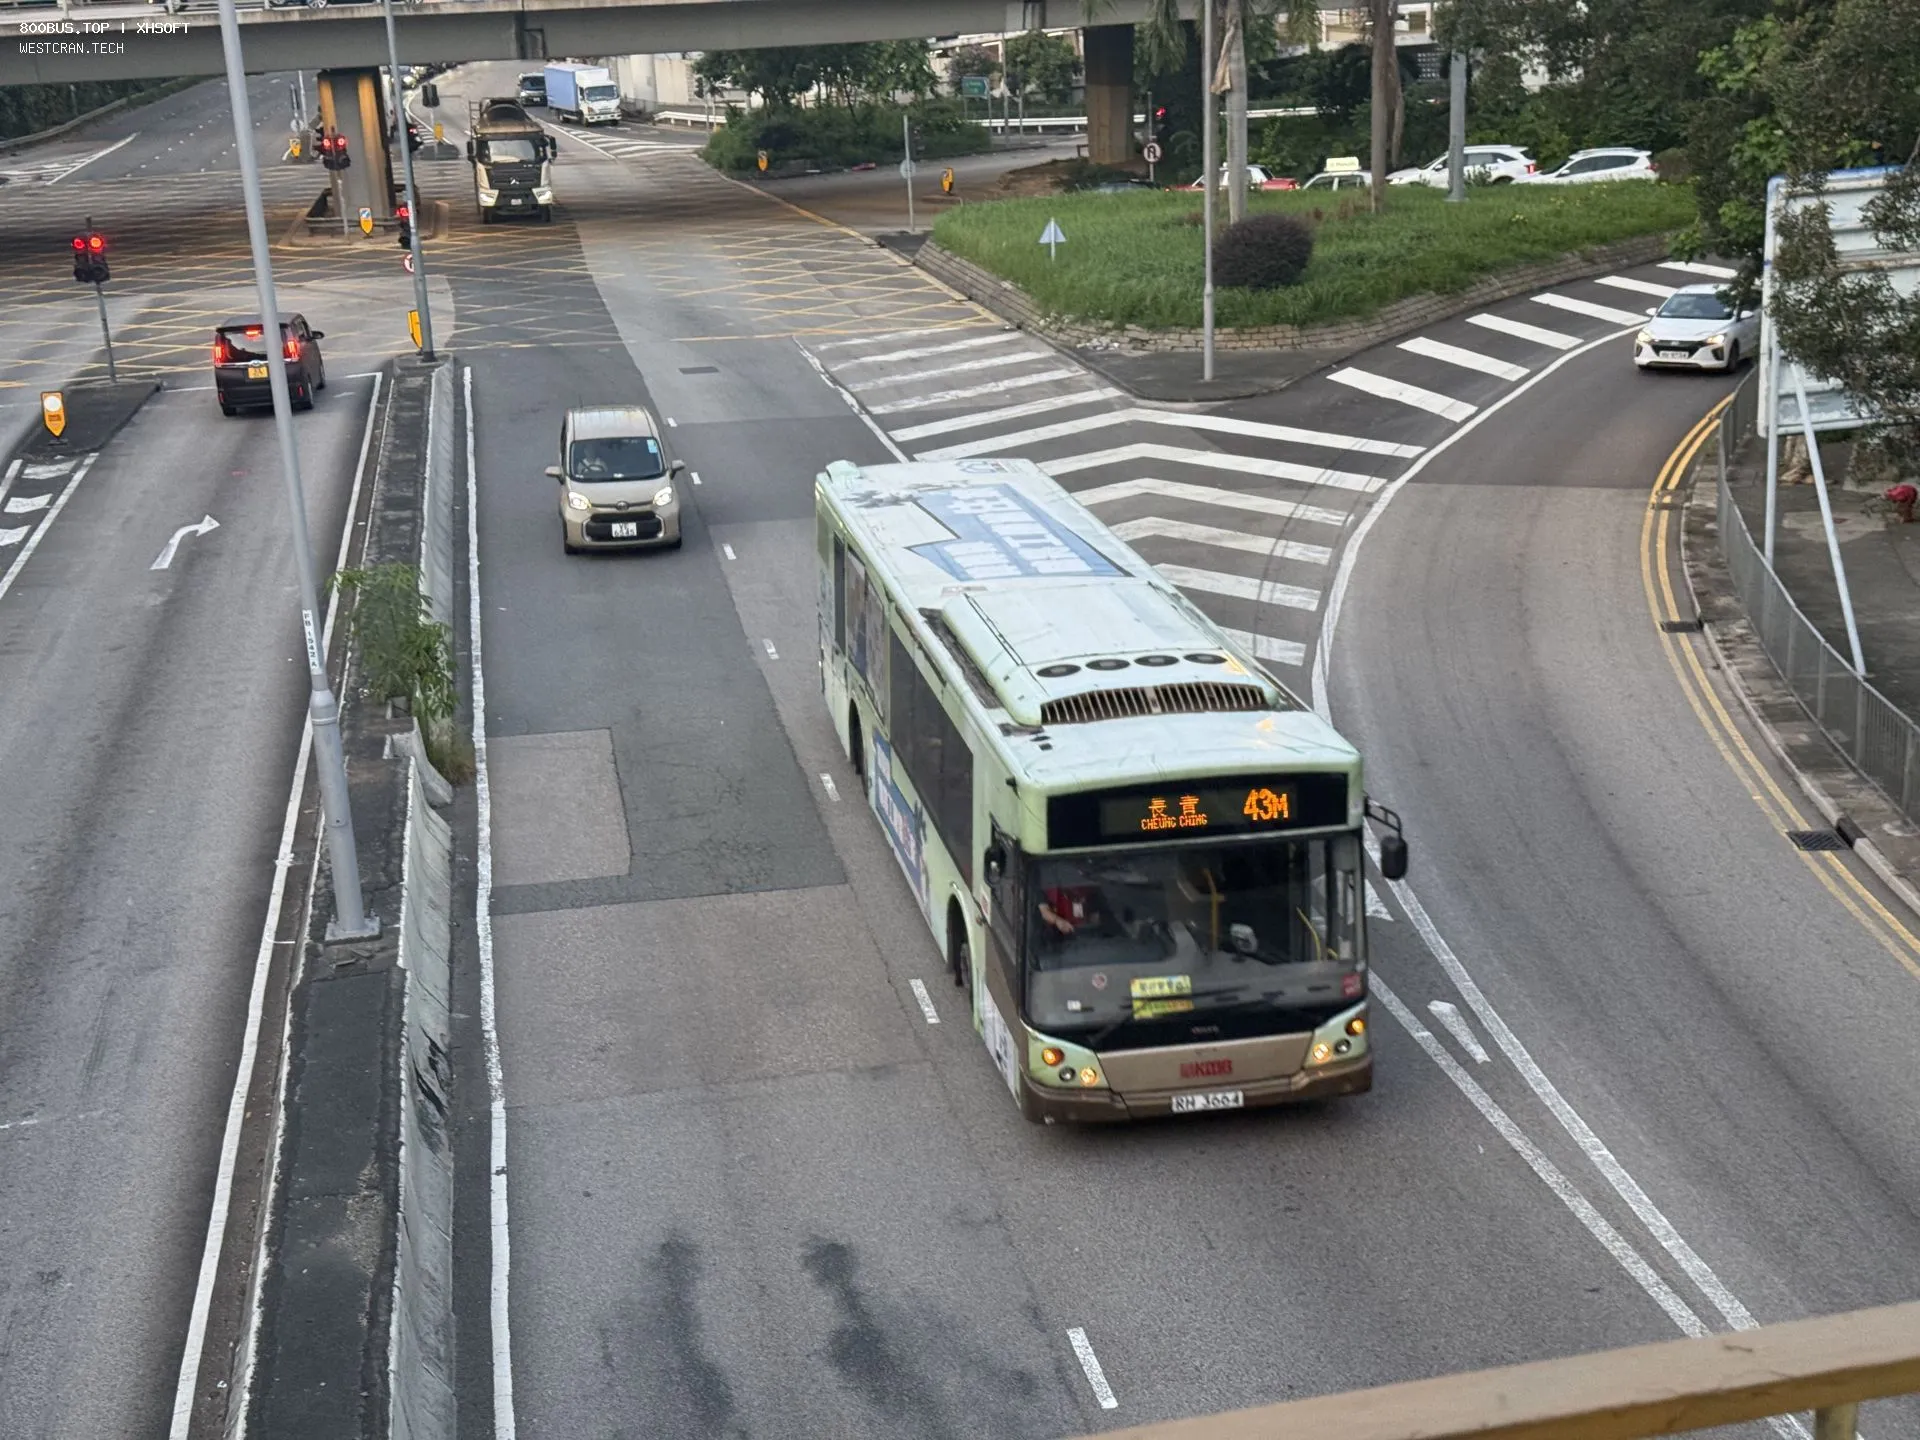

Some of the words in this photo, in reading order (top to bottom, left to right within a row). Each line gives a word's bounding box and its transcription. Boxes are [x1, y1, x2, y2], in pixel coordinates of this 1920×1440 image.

[1244, 788, 1289, 820] 43M
[1141, 816, 1176, 830] CHEUNG
[1179, 813, 1207, 827] CHING
